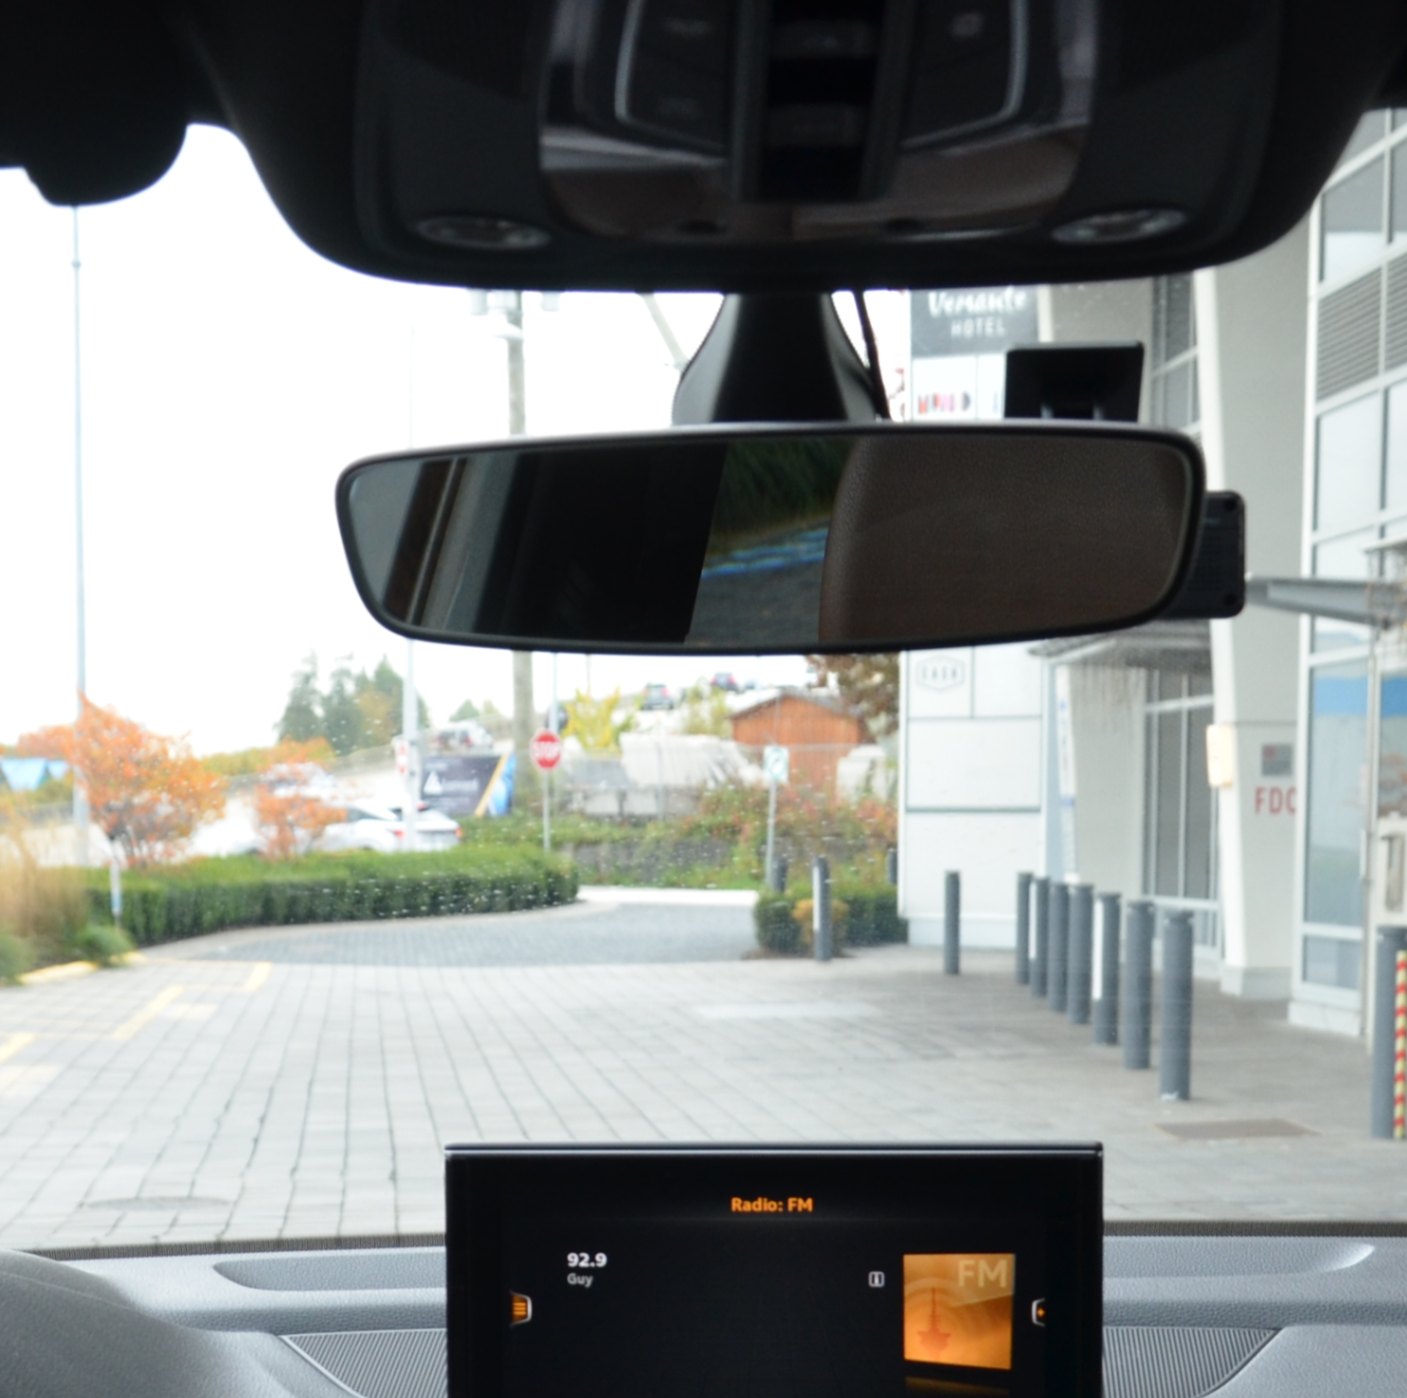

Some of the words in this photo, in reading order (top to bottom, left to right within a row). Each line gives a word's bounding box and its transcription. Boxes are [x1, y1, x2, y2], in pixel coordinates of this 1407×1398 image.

[952, 319, 1005, 338] HOTEL
[731, 1196, 783, 1213] Radio:
[788, 1197, 813, 1213] FM
[566, 1252, 608, 1268] 92.9
[567, 1272, 594, 1288] Guy
[957, 1259, 1008, 1288] FM
